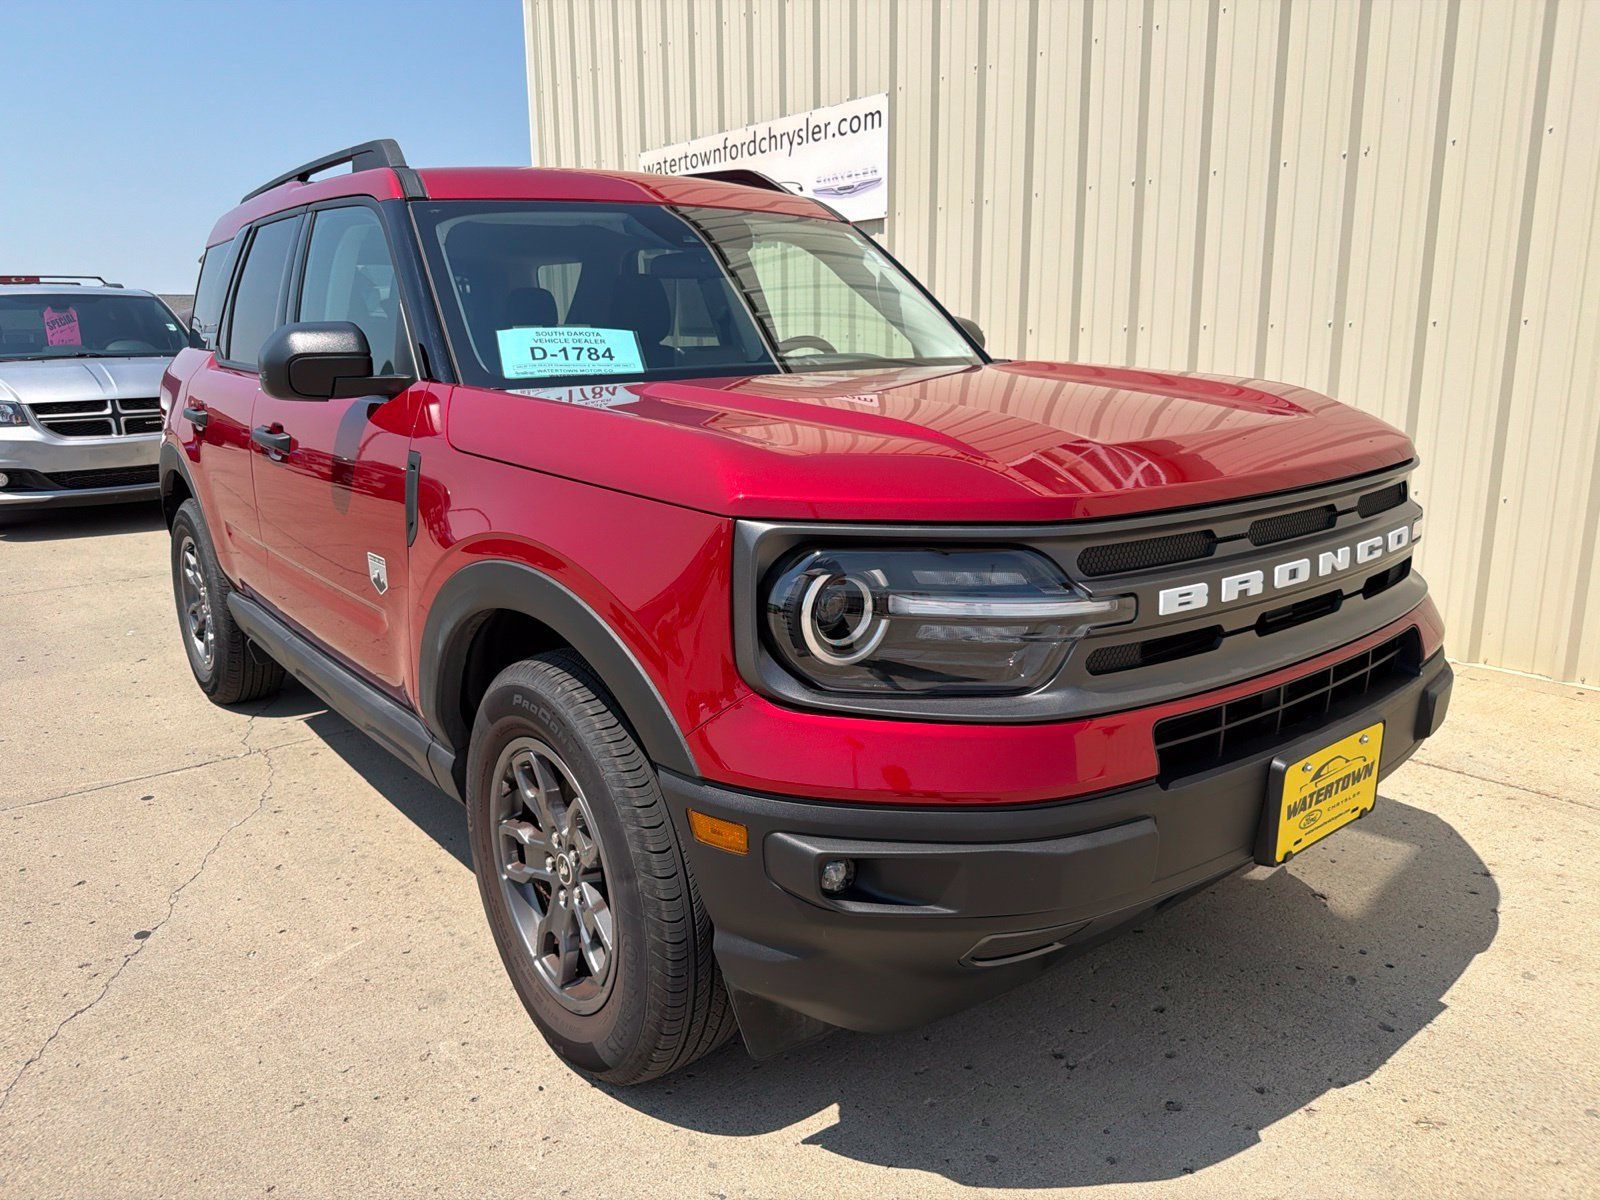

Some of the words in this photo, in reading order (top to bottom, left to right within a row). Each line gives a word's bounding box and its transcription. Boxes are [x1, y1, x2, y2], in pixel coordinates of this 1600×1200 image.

[643, 109, 882, 175] watertownfordchrysler.com
[46, 313, 76, 331] SPECIAL
[529, 346, 615, 361] D-1784
[1158, 525, 1409, 616] BRONCO
[1286, 760, 1376, 821] WATERTOWN
